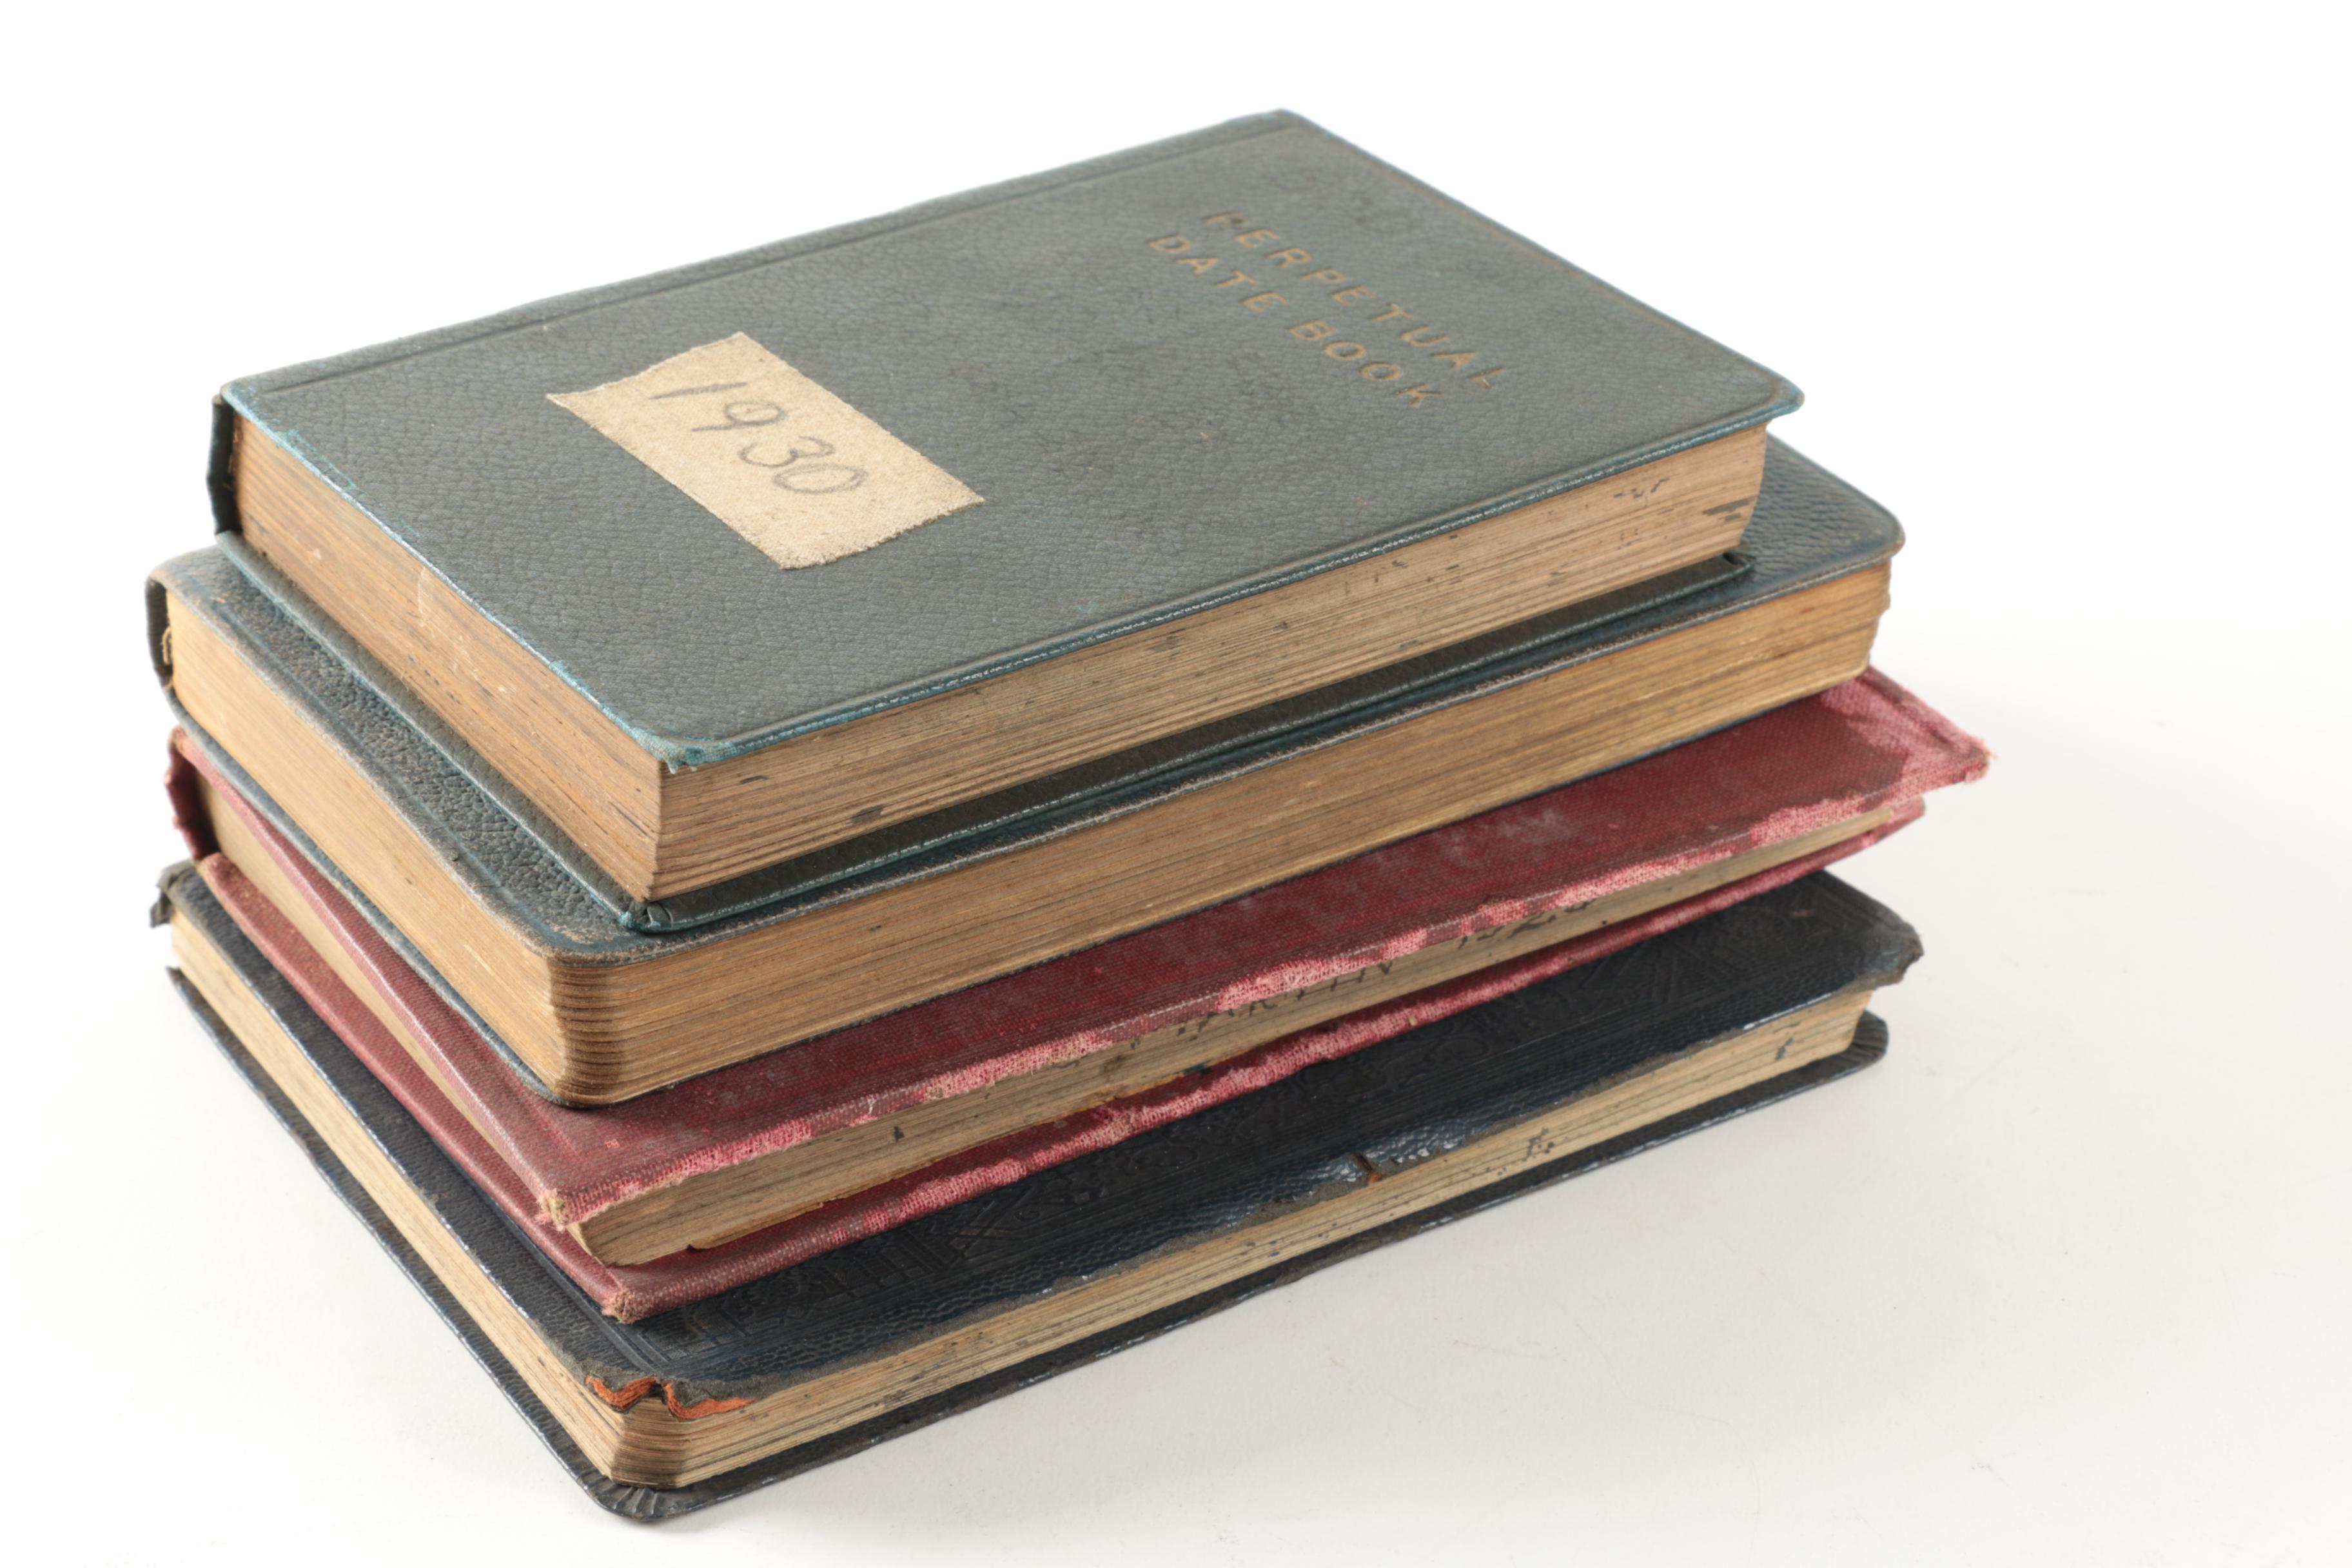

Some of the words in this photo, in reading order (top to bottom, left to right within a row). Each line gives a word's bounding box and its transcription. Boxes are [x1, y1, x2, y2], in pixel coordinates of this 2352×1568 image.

[1148, 233, 1288, 312] DATE
[1289, 320, 1443, 407] BOOK
[1202, 211, 1505, 388] PERPETUAL
[649, 382, 869, 495] 1930
